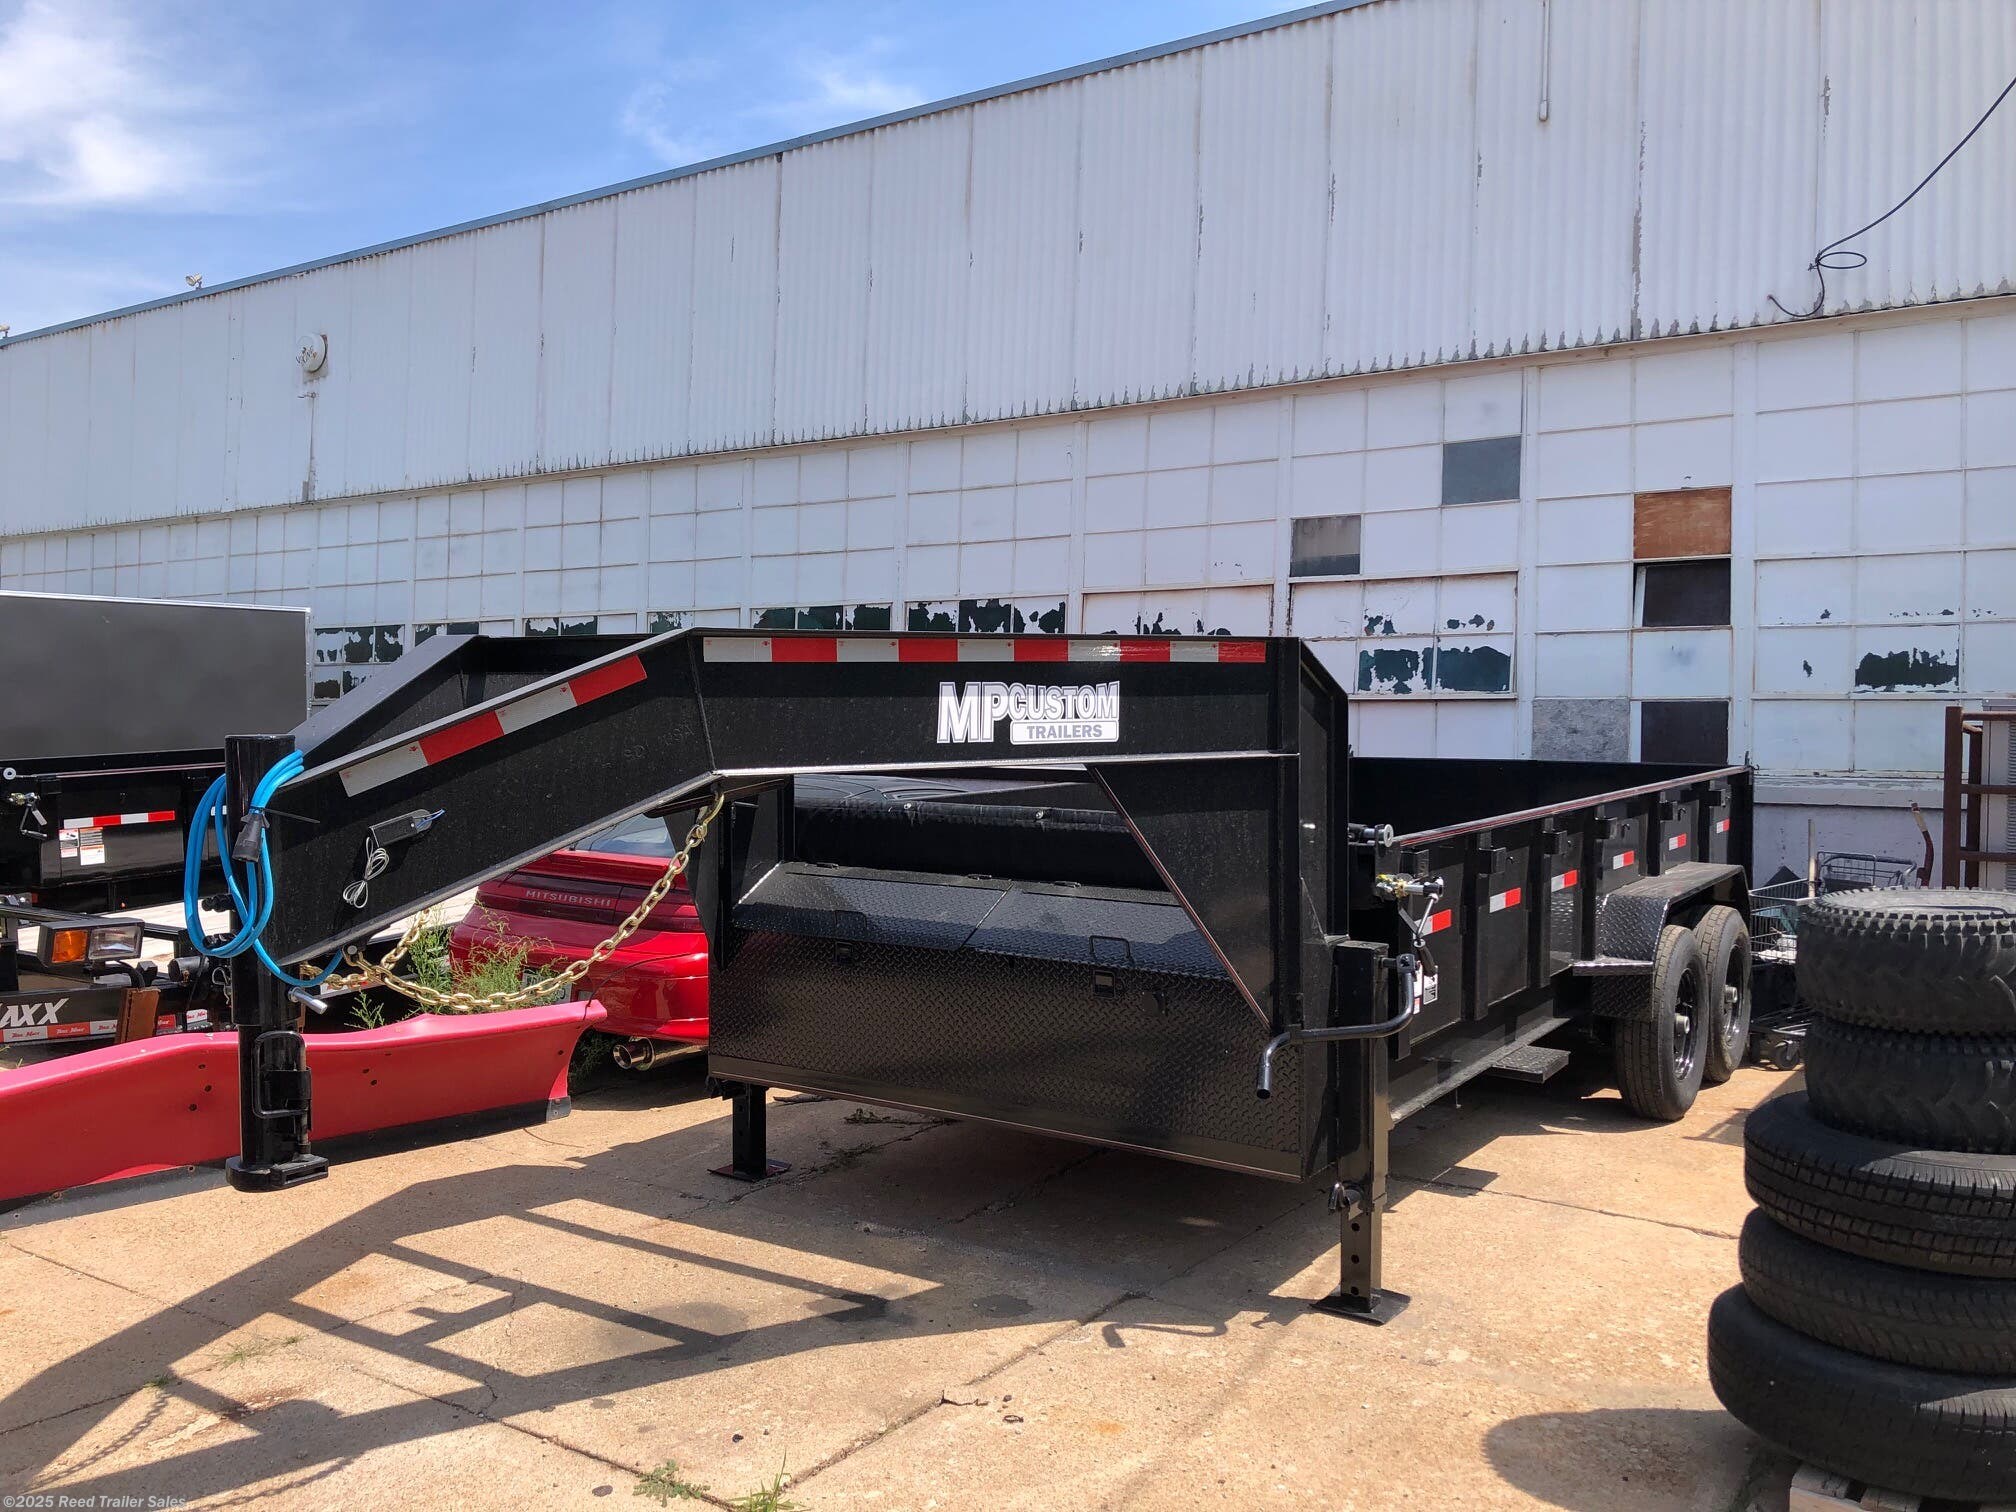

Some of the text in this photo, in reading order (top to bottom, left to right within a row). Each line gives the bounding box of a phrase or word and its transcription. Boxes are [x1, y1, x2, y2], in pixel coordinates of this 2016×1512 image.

[937, 681, 1120, 743] MP CUSTOM
[1027, 725, 1102, 739] TRAILERS
[526, 890, 611, 906] MITSUBISHI
